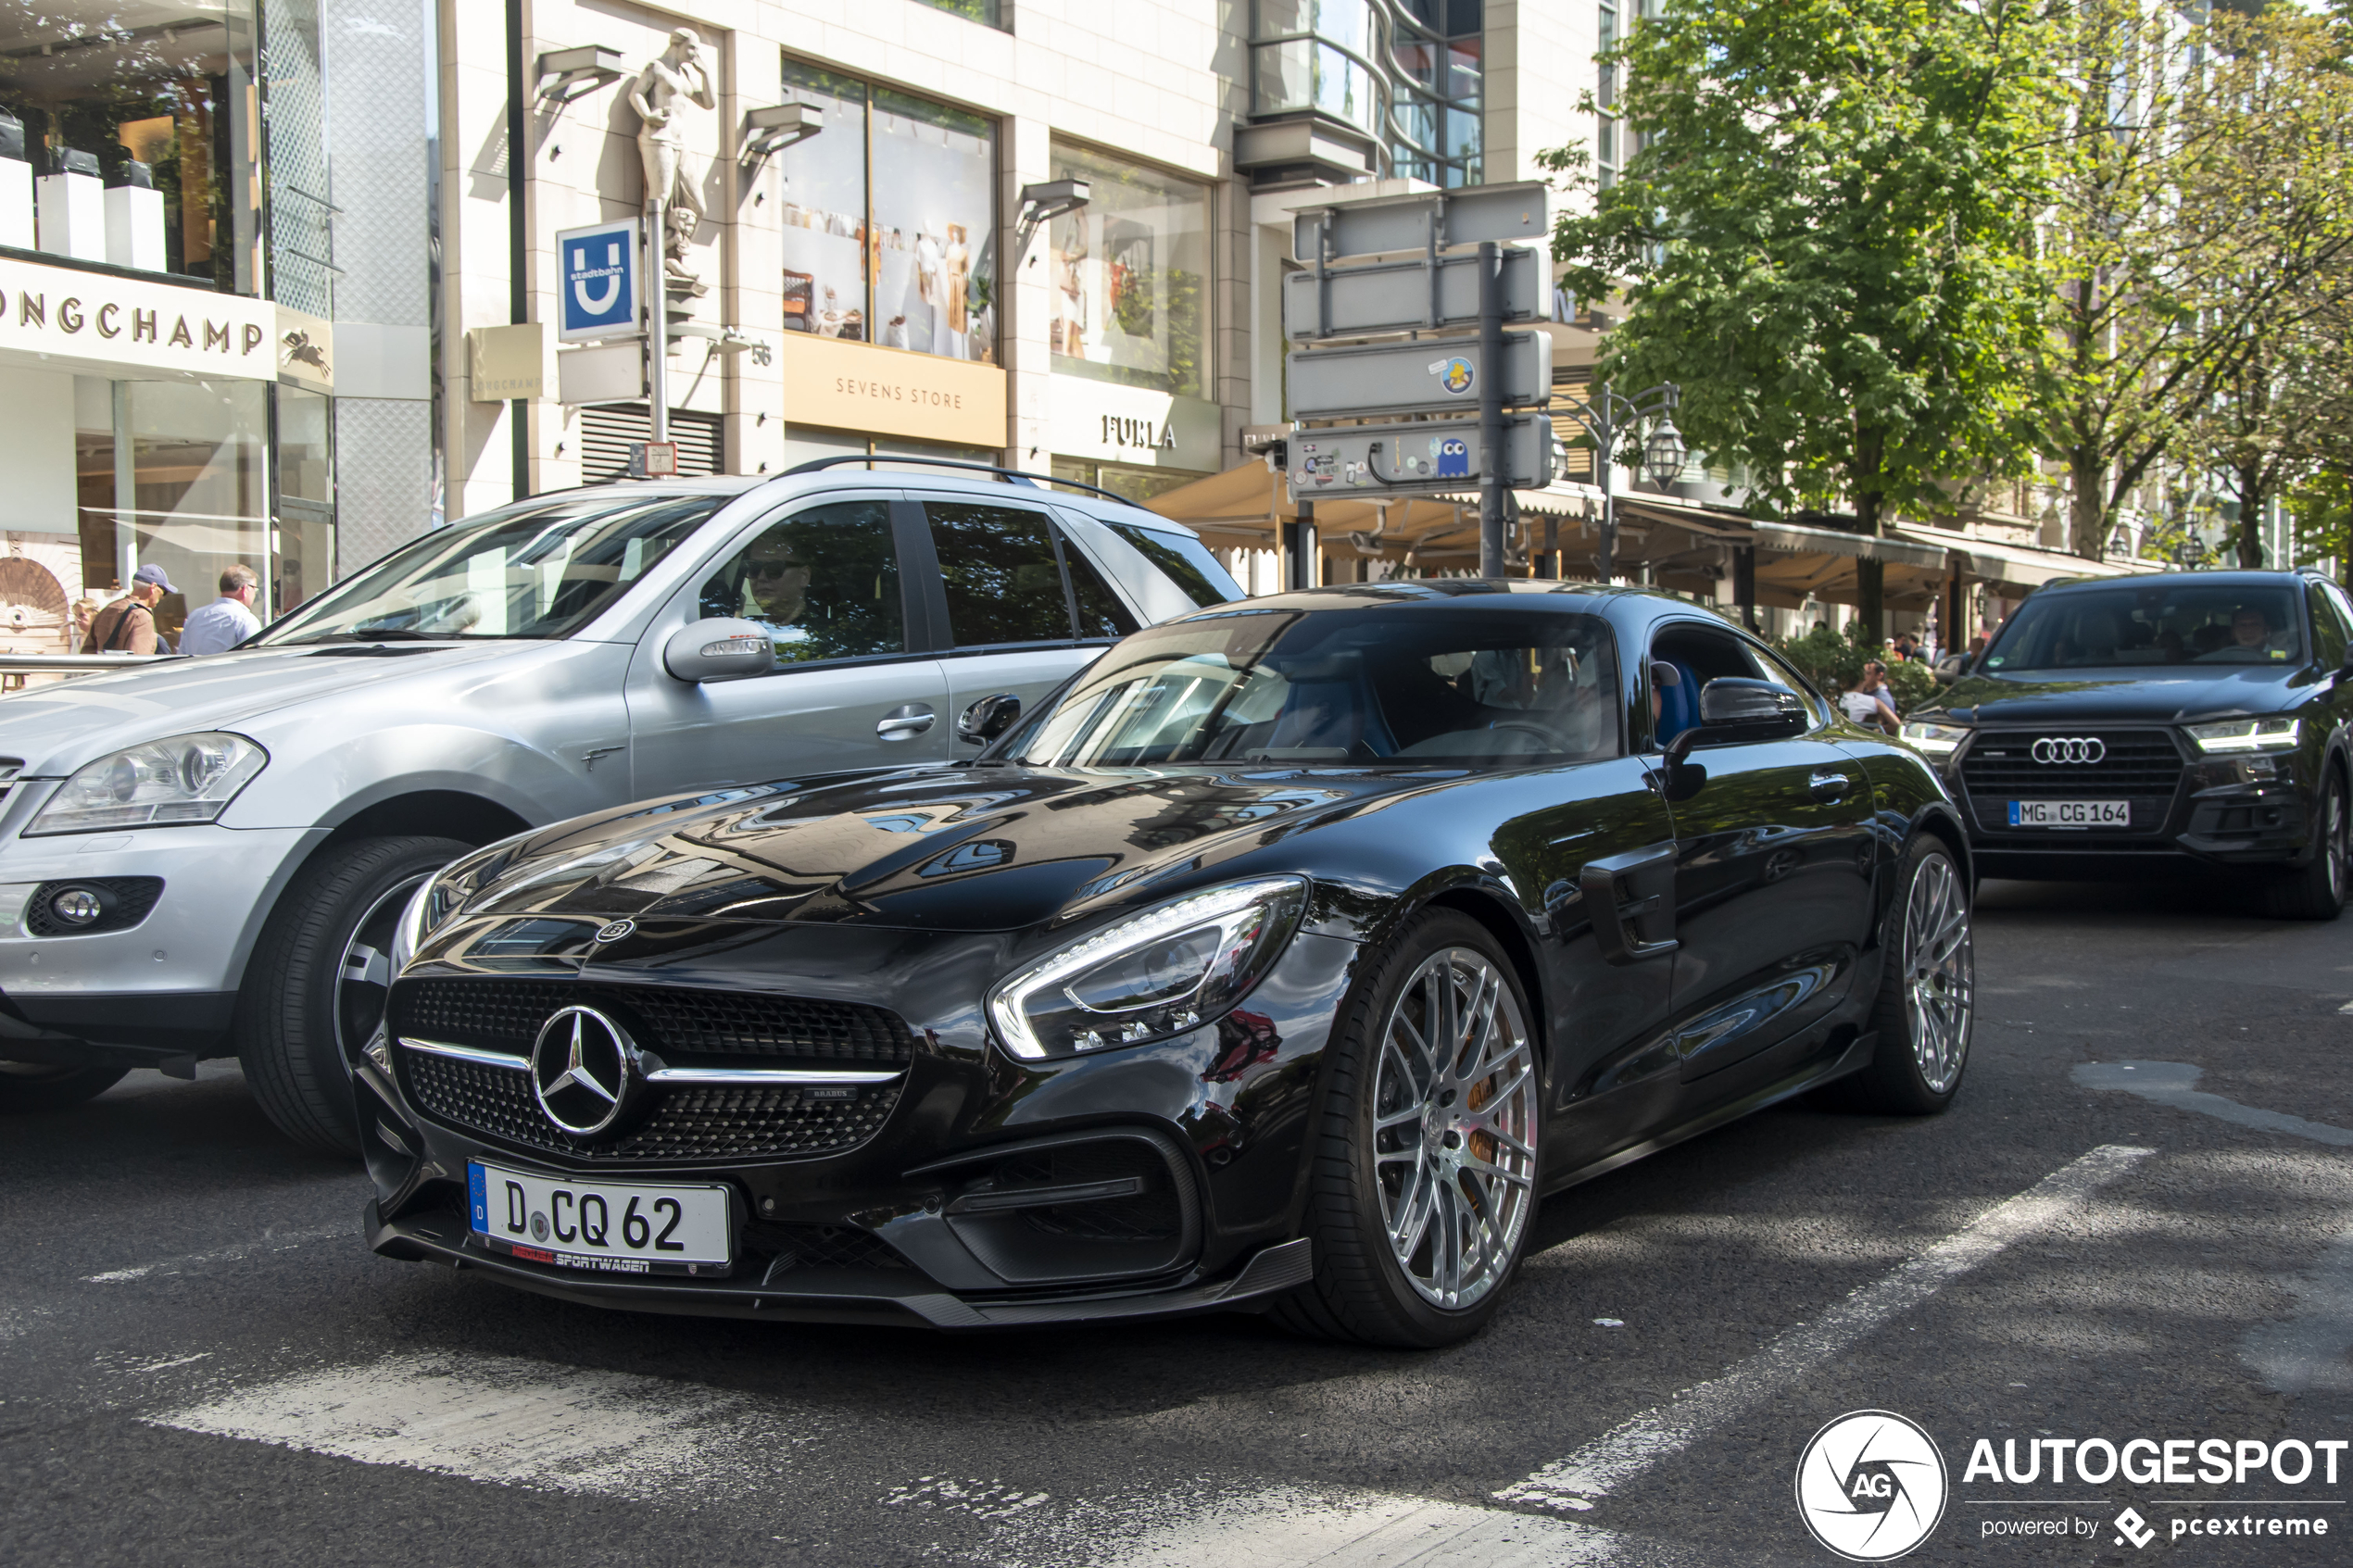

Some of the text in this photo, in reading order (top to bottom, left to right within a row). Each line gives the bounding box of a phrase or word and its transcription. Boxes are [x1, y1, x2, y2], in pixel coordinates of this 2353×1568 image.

[570, 266, 623, 281] stadtbahn
[0, 288, 263, 356] NGCHAMP
[836, 377, 962, 409] SEVENS STORE
[1101, 414, 1176, 449] FURLA
[2020, 803, 2127, 822] MG CG 164
[813, 1089, 848, 1098] BRABUS
[476, 1205, 484, 1220] D
[506, 1179, 685, 1251] D CQ 62
